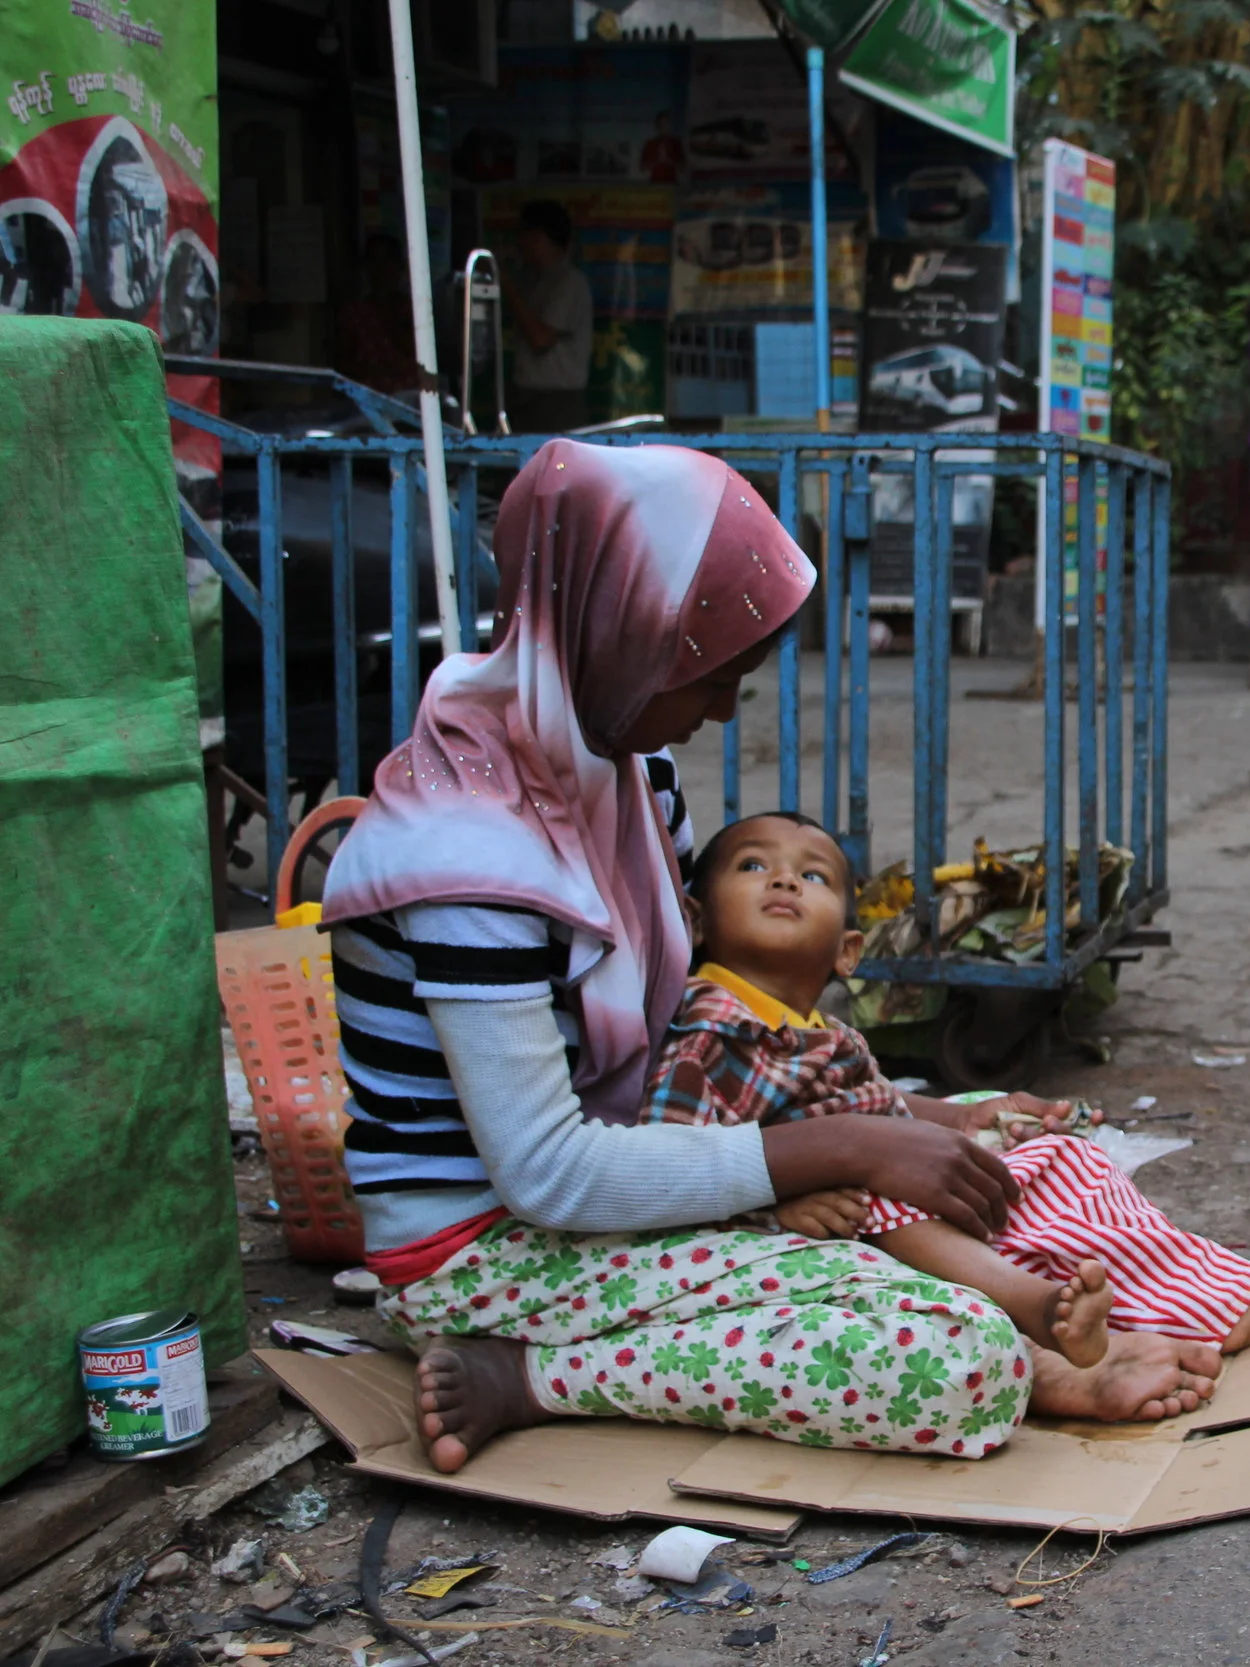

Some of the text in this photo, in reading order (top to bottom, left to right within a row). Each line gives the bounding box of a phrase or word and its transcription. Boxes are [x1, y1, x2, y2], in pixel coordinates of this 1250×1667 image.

[83, 1353, 142, 1372] MARIGOLD
[118, 1430, 163, 1442] BEVERAGE
[100, 1442, 135, 1451] CREAMER
